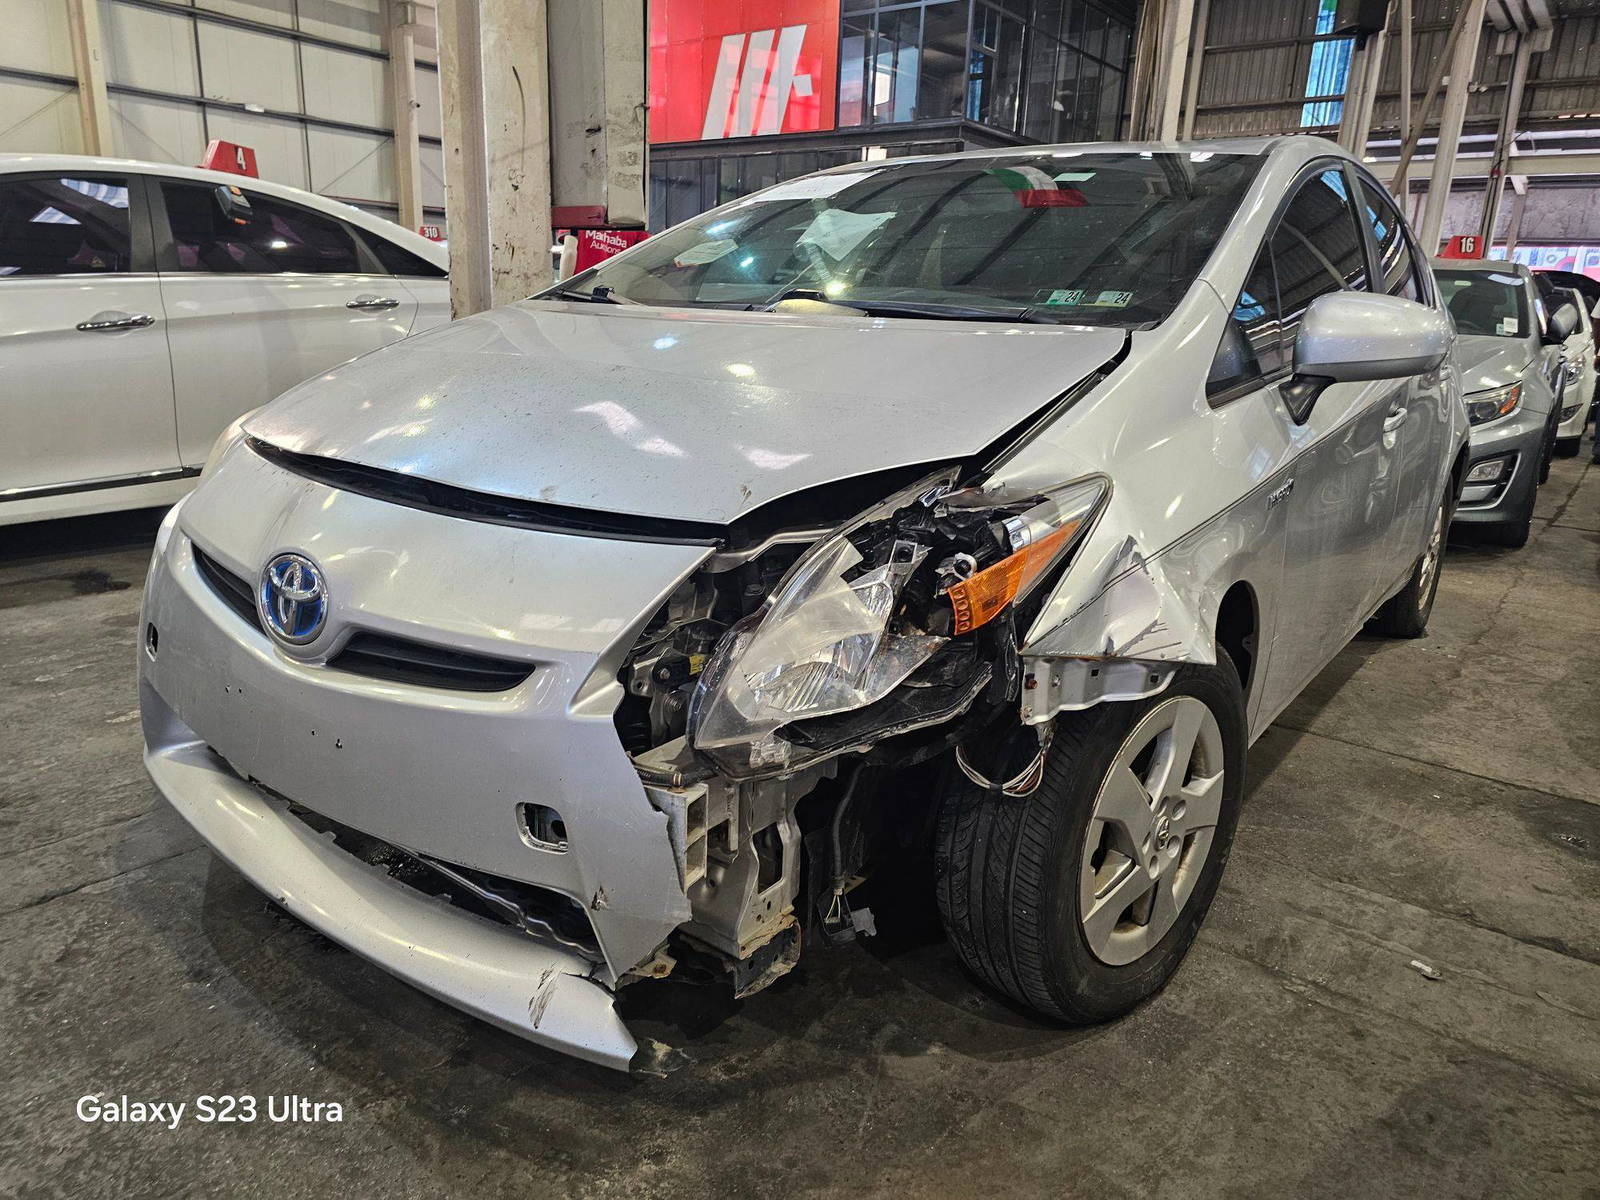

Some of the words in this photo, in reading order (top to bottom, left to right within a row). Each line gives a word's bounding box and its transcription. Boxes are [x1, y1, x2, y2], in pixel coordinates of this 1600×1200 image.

[237, 147, 246, 170] 4
[423, 227, 438, 238] 310
[1460, 237, 1474, 253] 16
[1065, 291, 1080, 302] 24
[1115, 293, 1130, 304] 24
